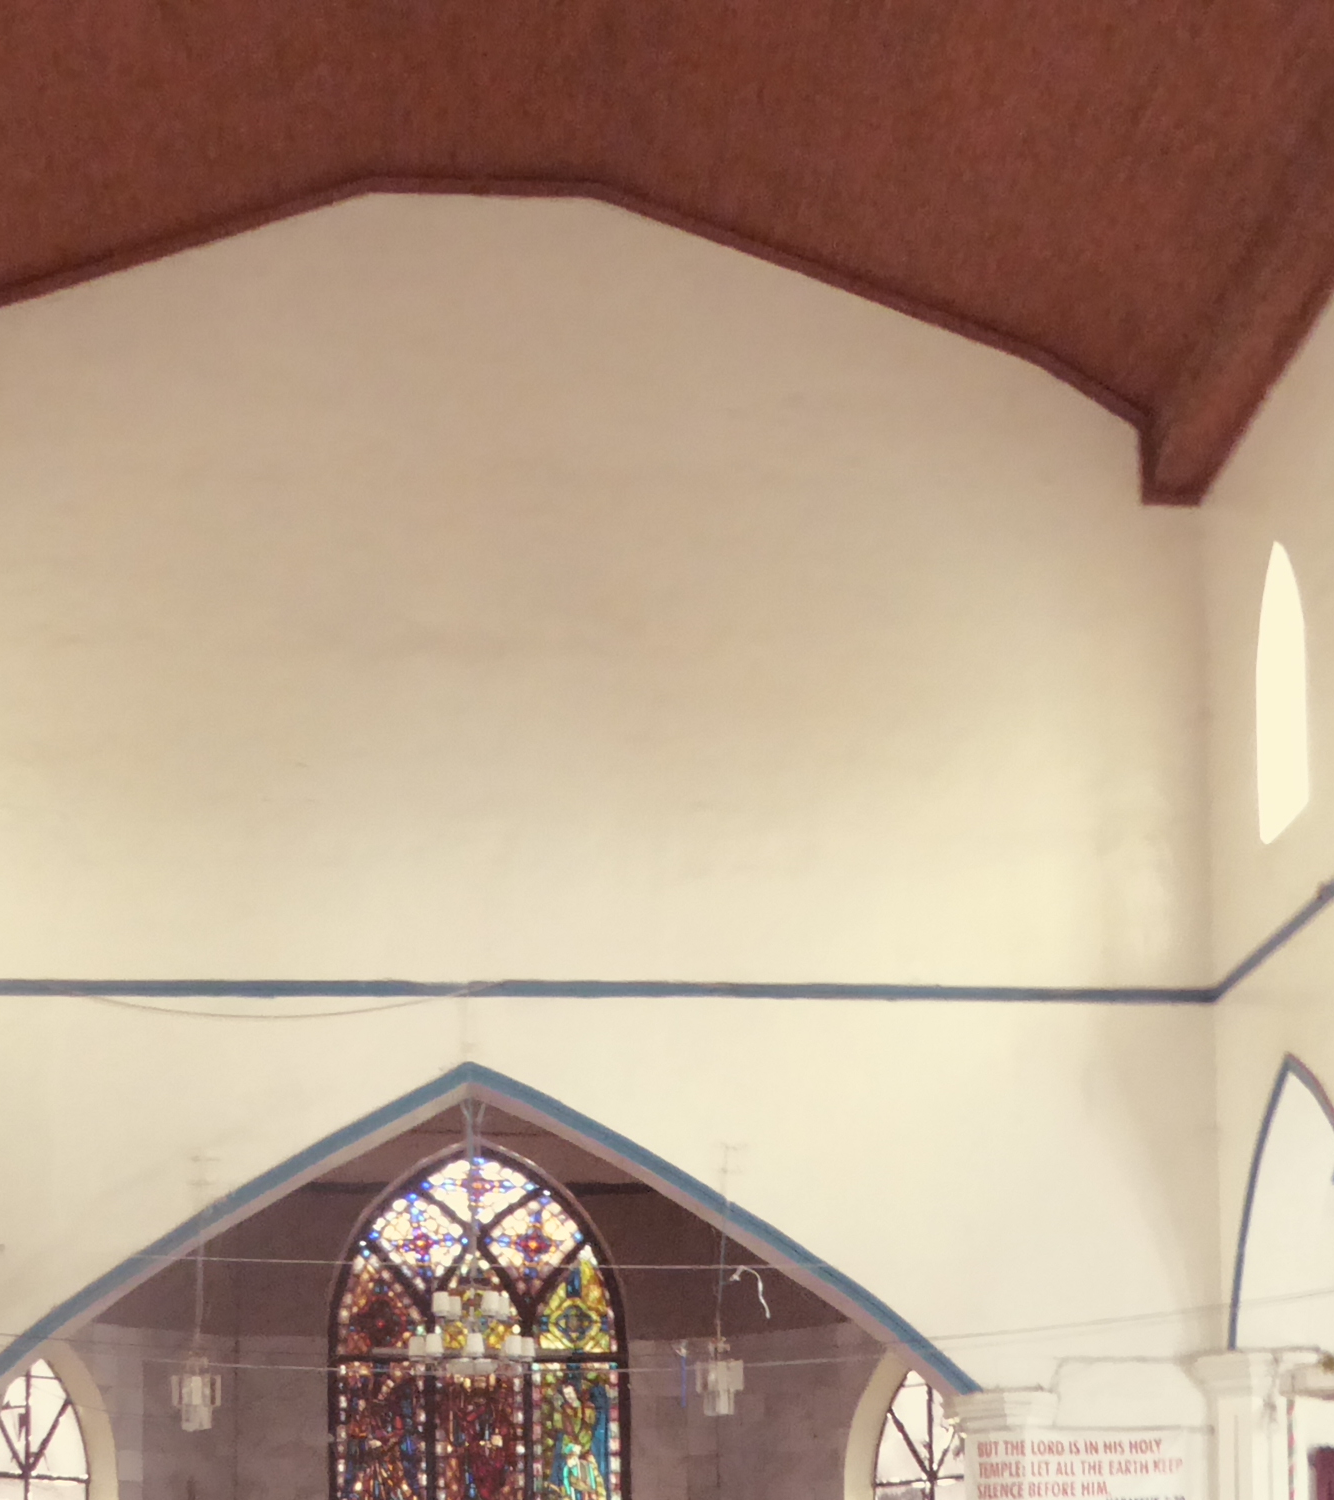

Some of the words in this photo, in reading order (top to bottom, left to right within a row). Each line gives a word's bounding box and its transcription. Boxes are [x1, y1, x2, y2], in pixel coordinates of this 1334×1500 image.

[977, 1439, 1000, 1458] BUT
[1003, 1439, 1026, 1457] THE
[1030, 1439, 1065, 1456] LORD
[1068, 1439, 1081, 1457] IS
[1083, 1438, 1099, 1456] IN
[1103, 1438, 1125, 1456] HIS
[1129, 1437, 1162, 1455] HOLY
[1031, 1460, 1050, 1477] LET
[1055, 1460, 1076, 1477] ALL
[1080, 1460, 1103, 1476] THE
[1108, 1459, 1149, 1476] EARTH
[1152, 1458, 1183, 1474] KEEP
[977, 1480, 1024, 1500] SILENCE
[1028, 1480, 1076, 1498] BEFORE
